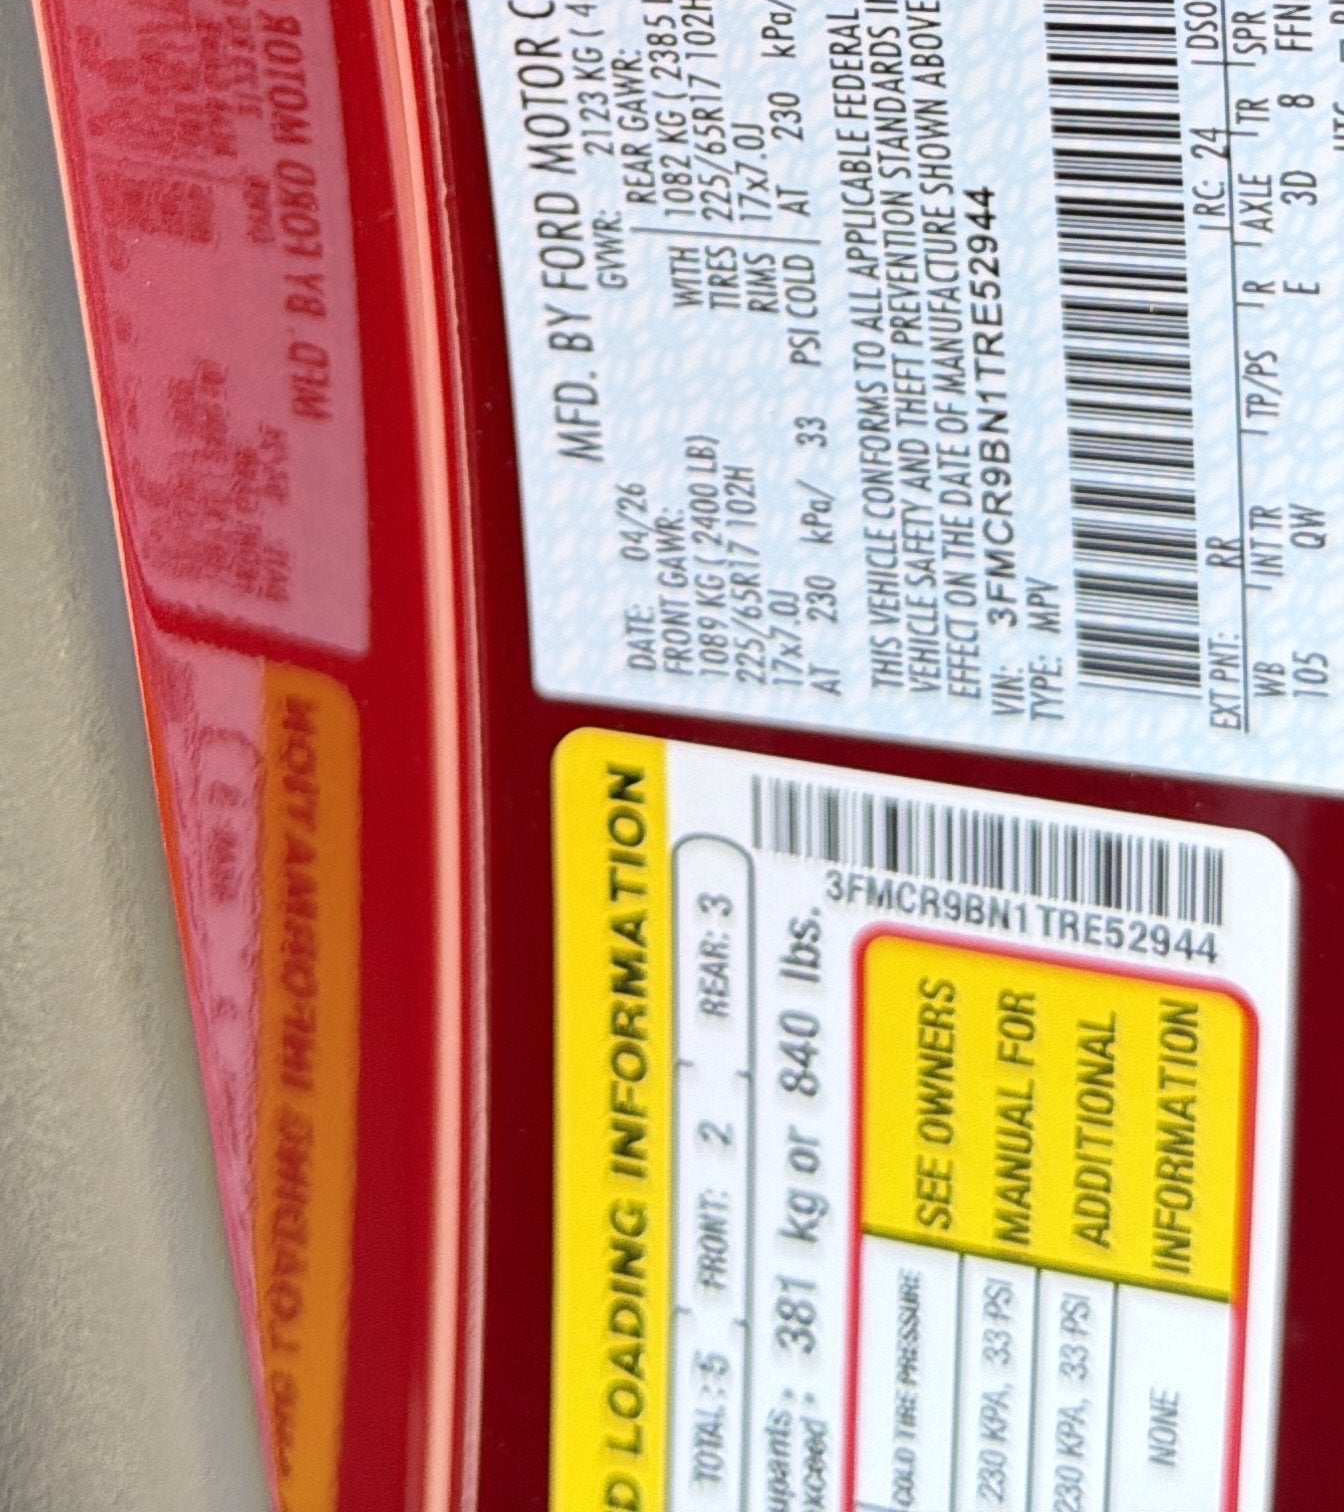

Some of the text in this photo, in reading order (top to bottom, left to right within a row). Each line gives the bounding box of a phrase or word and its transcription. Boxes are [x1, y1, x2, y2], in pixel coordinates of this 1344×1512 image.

[573, 47, 604, 82] KG
[643, 14, 681, 79] 2385
[824, 8, 867, 120] FEDERAL
[1232, 11, 1268, 55] SPR
[513, 36, 577, 175] MOTOR
[583, 91, 614, 156] 2123
[611, 49, 657, 204] REAR GAWR:
[655, 111, 688, 144] KG
[770, 92, 803, 142] 230
[869, 25, 910, 180] STANDARDS
[1236, 98, 1270, 124] TR
[1277, 94, 1315, 109] 8
[687, 74, 734, 222] 225/65R17
[731, 122, 772, 222] 17x7.0J
[912, 98, 954, 196] SHOWN
[1190, 128, 1230, 217] RC: 24
[663, 155, 695, 218] 1082
[776, 185, 810, 217] AT
[835, 129, 882, 281] APPLICABLE
[1238, 174, 1273, 233] AXLE
[1279, 170, 1318, 206] 3D
[534, 191, 587, 291] FORD
[593, 210, 629, 290] GVWR:
[668, 247, 703, 309] WITH
[706, 246, 741, 310] TIRES
[878, 191, 924, 347] PREVENTION
[743, 252, 779, 314] RIMS
[782, 255, 822, 366] PSI COLD
[848, 287, 881, 331] ALL
[922, 206, 967, 395] MANUFACTURE
[1243, 280, 1276, 295] R
[1283, 281, 1320, 295] E
[546, 304, 594, 353] BY
[851, 340, 884, 371] TO
[552, 370, 604, 463] MFD.
[893, 356, 928, 428] THEFT
[933, 402, 969, 434] OF
[1244, 350, 1284, 418] TP/PS
[685, 434, 719, 474] LB)
[854, 381, 896, 519] CONFORMS
[897, 439, 932, 491] AND
[934, 442, 973, 508] DATE
[963, 187, 1025, 717] VIN: 3FMCR9BN1TRE52944
[690, 483, 722, 544] 2400
[901, 497, 937, 587] SAFETY
[940, 516, 975, 560] THE
[1247, 505, 1284, 577] INT TR
[1289, 503, 1326, 549] QW
[616, 482, 657, 671] DATE: 04/26
[655, 508, 694, 676] FRONT GAWR:
[694, 572, 725, 608] KG
[723, 465, 765, 685] 225/65R17 102H
[794, 416, 841, 696] AT 230 kPa/ 33
[864, 529, 901, 626] VEHICLE
[942, 571, 977, 608] ON
[697, 617, 729, 677] 1089
[768, 590, 802, 687] 17x7.0J
[870, 637, 904, 689] THIS
[906, 598, 941, 693] VEHICLE
[945, 614, 982, 699] EFFECT
[1025, 576, 1064, 722] TYPE: MPV
[1205, 536, 1243, 730] EXT PNT: RR
[1252, 662, 1286, 698] WB
[1292, 652, 1330, 699] 105
[779, 907, 822, 984] lbs.
[825, 870, 1217, 964] 3FMCR9BN1TRE52944
[606, 761, 648, 1180] INFORMATION
[697, 892, 732, 1017] REAR: 3
[778, 1009, 821, 1098] 840
[915, 976, 957, 1230] SEE OWNERS
[994, 988, 1036, 1246] MANUAL FOR
[1072, 1012, 1117, 1250] ADDITIONAL
[1152, 997, 1198, 1276] INFORMATION
[786, 1124, 820, 1174] or
[693, 1120, 733, 1290] FRONT: 2
[777, 1187, 829, 1243] kg
[606, 1198, 645, 1456] LOADING
[774, 1274, 817, 1354] 381
[982, 1278, 1014, 1322] PSI
[1060, 1290, 1091, 1337] PSI
[980, 1328, 1012, 1366] 33
[1058, 1343, 1089, 1381] 33
[892, 1268, 922, 1505] COLD TIRE PRESSURE
[799, 1416, 827, 1512] xceed
[1148, 1387, 1180, 1467] NONE
[977, 1449, 1006, 1503] 230
